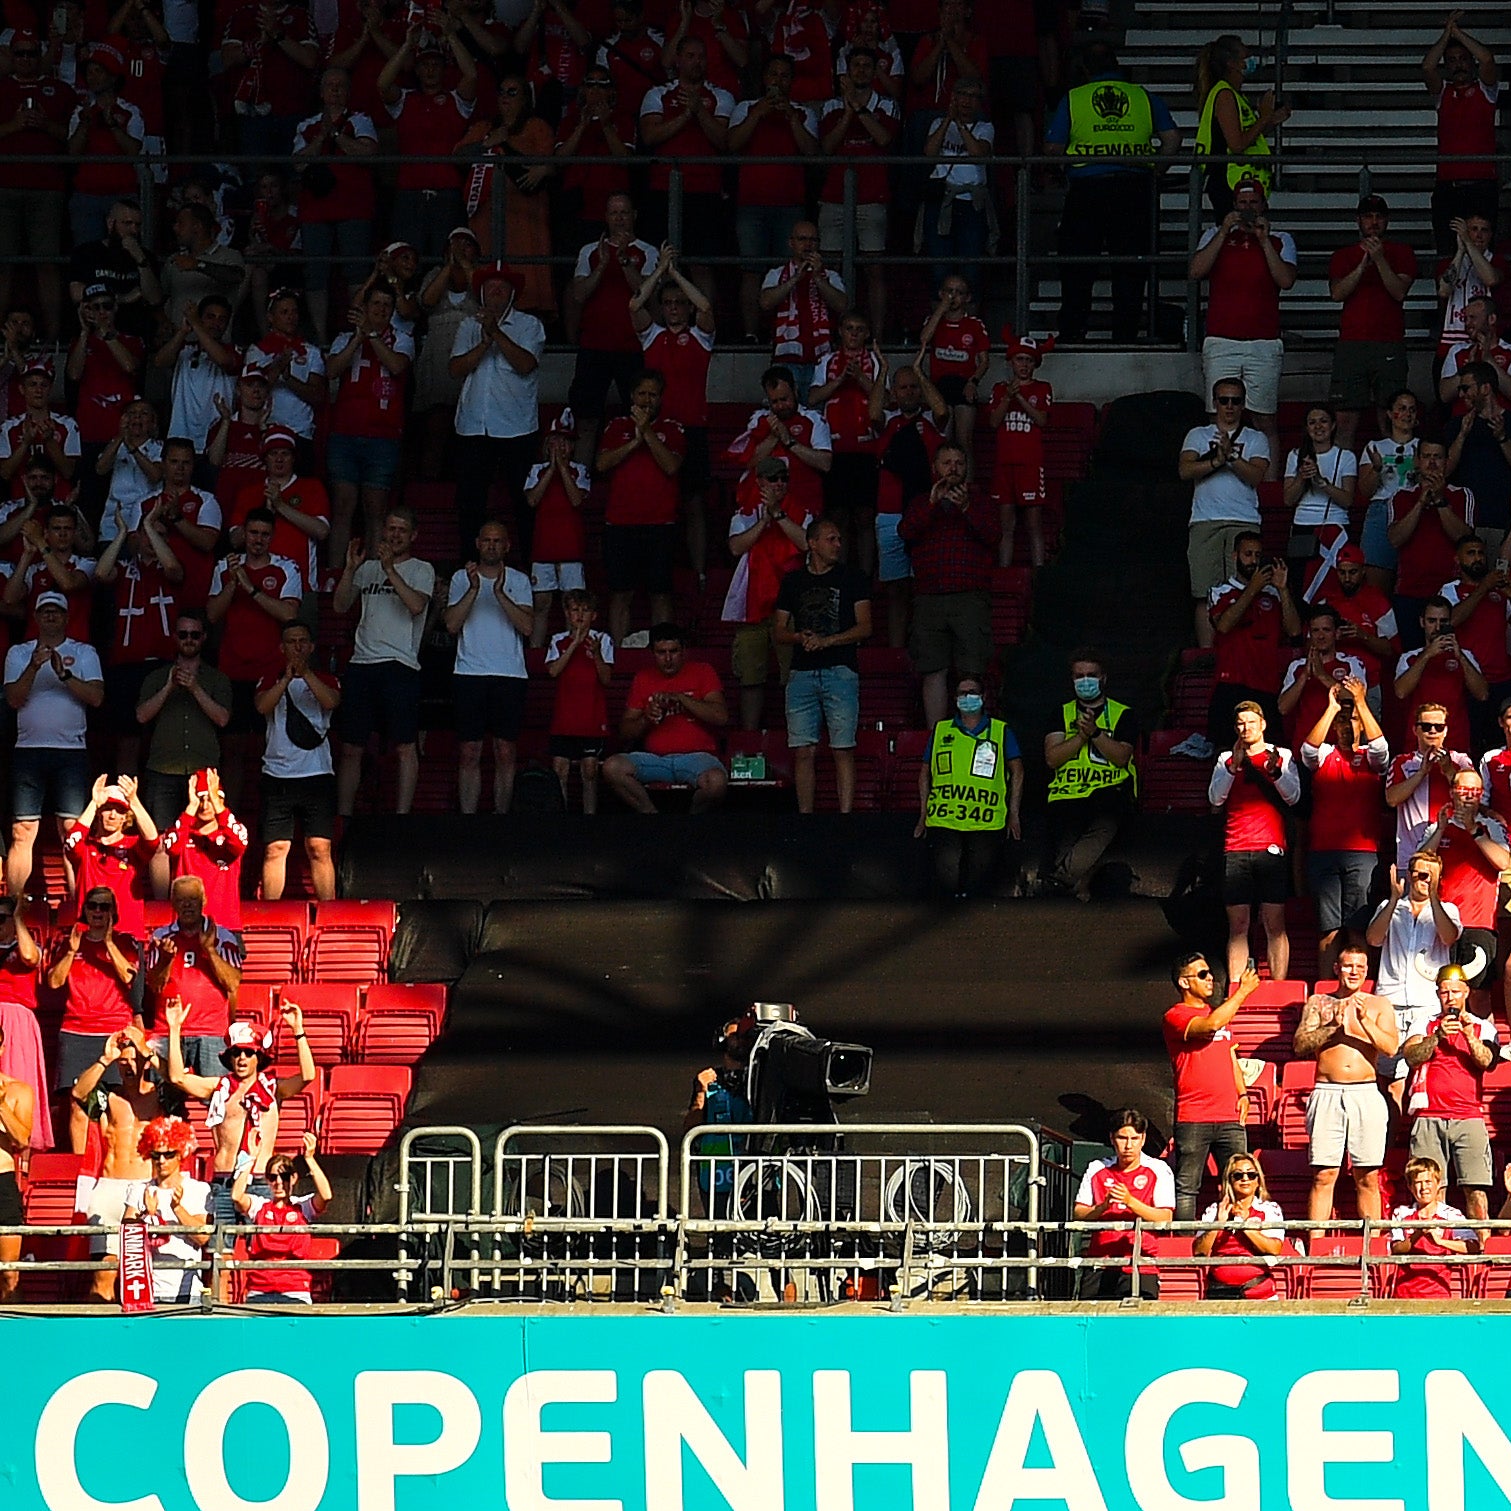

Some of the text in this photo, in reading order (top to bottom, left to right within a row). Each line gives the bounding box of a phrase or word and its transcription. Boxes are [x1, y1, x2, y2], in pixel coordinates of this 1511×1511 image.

[131, 59, 143, 77] 10
[930, 785, 999, 807] STEWARD
[184, 952, 195, 968] 9
[121, 1224, 141, 1281] ANMARK
